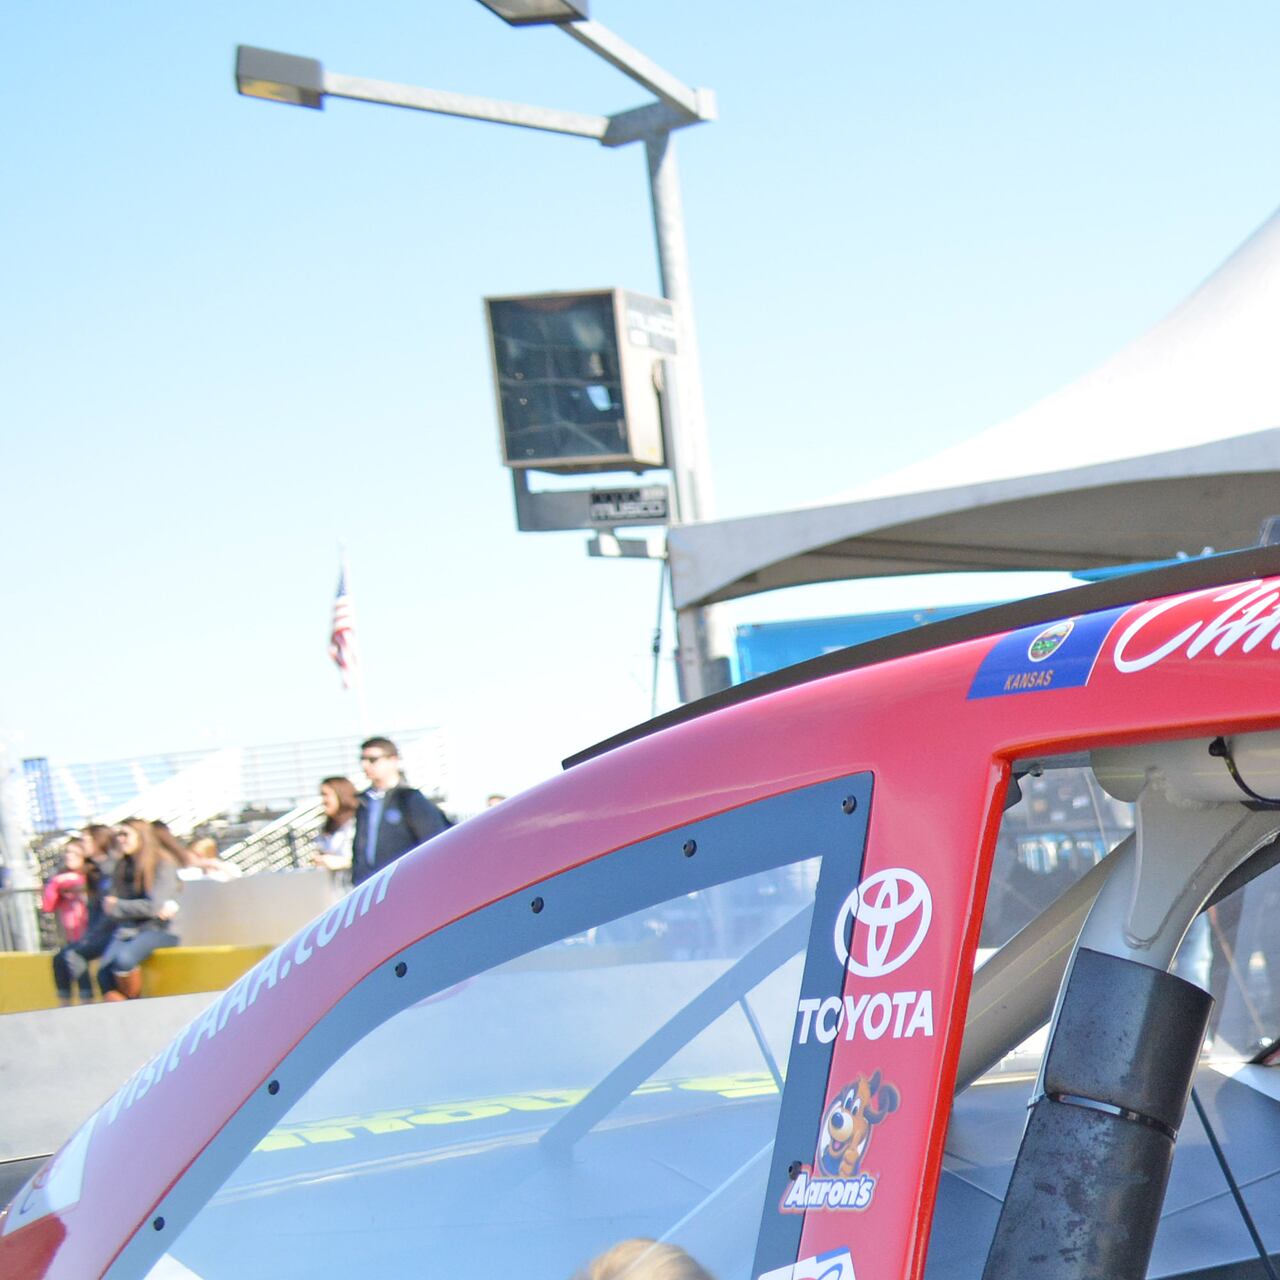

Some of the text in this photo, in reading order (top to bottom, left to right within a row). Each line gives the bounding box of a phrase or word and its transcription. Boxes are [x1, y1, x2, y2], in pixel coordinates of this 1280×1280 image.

[1003, 669, 1055, 690] KANSAS
[798, 990, 934, 1044] TOYOTA
[784, 1171, 873, 1208] Aaron's
